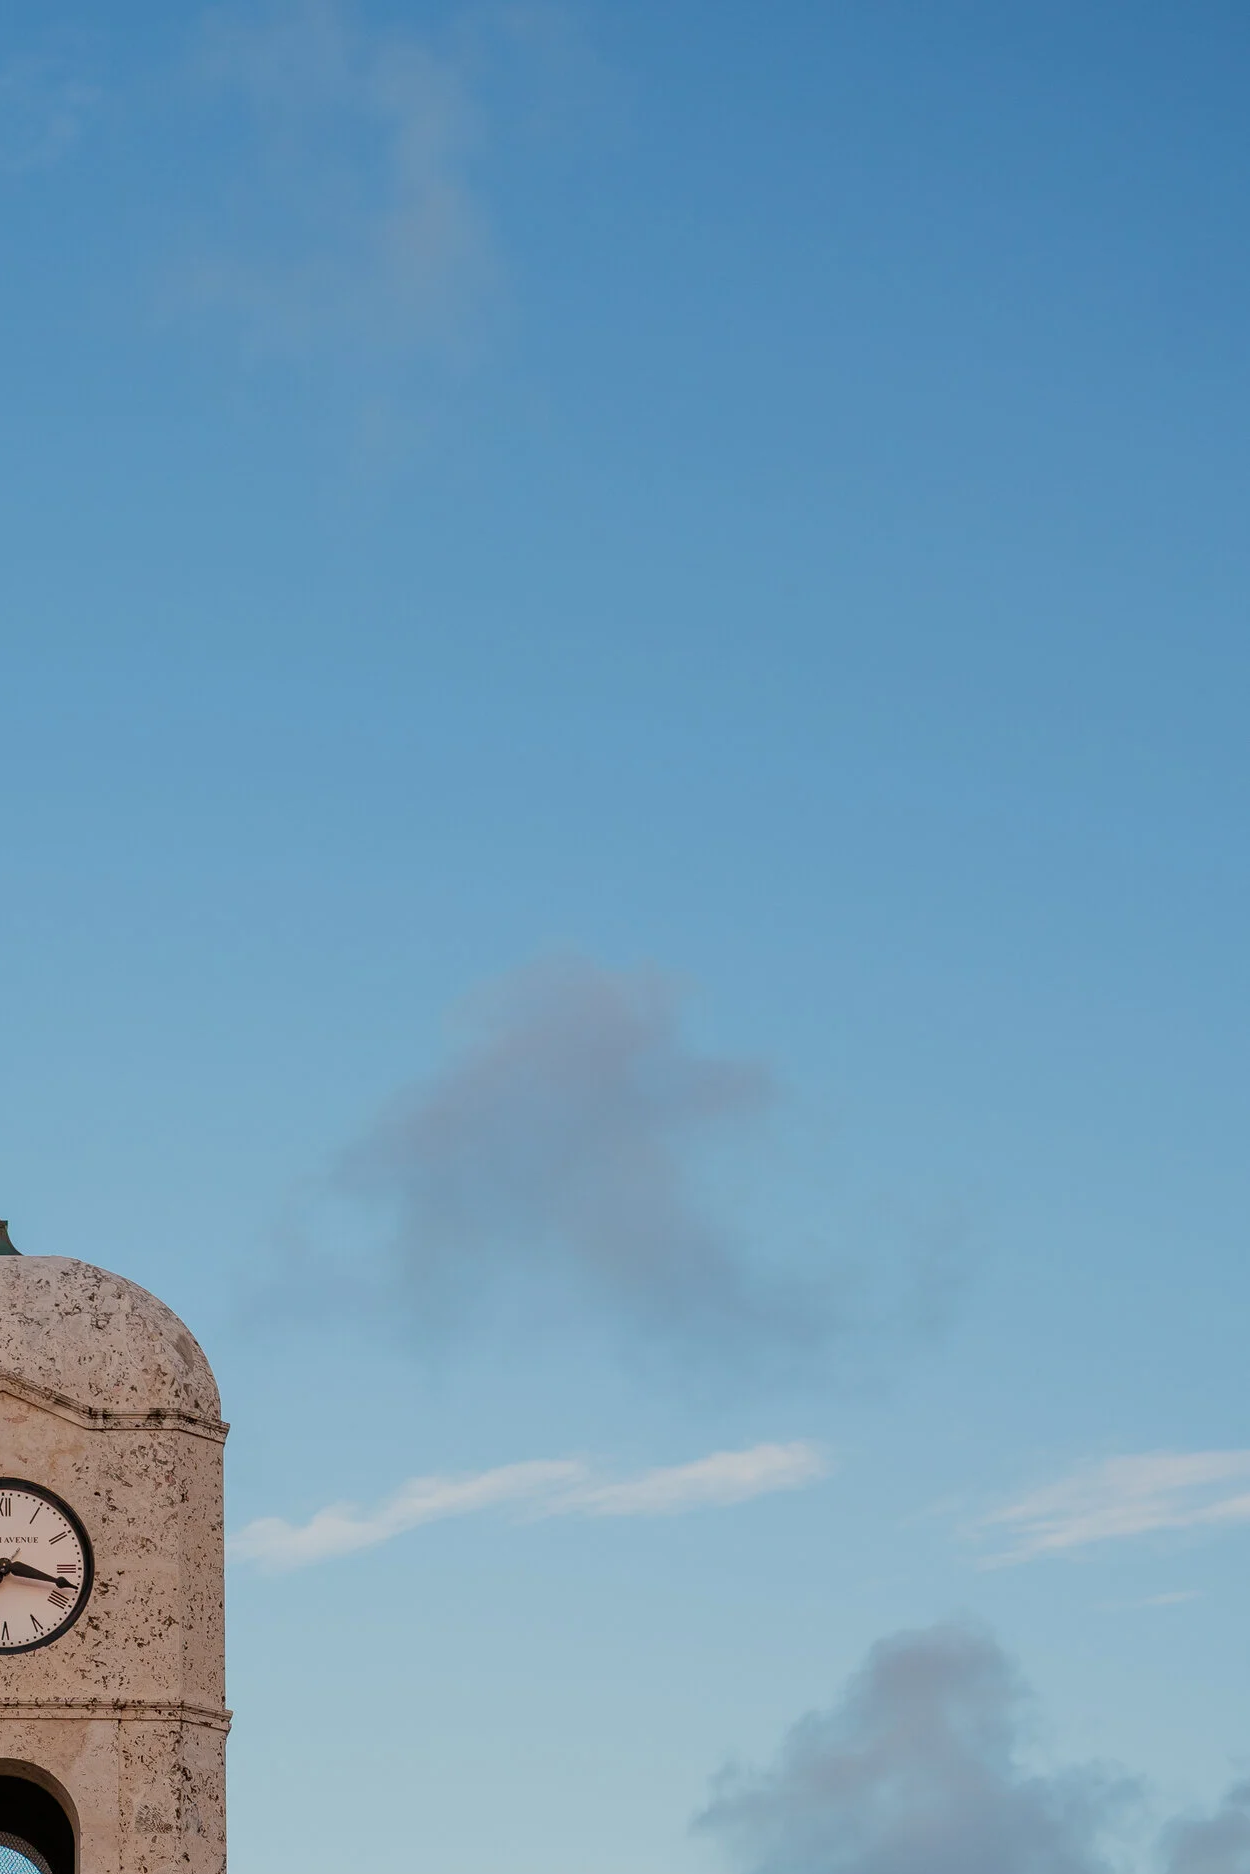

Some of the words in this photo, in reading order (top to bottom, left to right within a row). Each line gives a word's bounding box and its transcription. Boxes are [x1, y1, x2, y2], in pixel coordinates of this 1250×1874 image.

[30, 1507, 41, 1524] I
[49, 1531, 68, 1544] II
[57, 1564, 76, 1573] III
[30, 1614, 42, 1632] V
